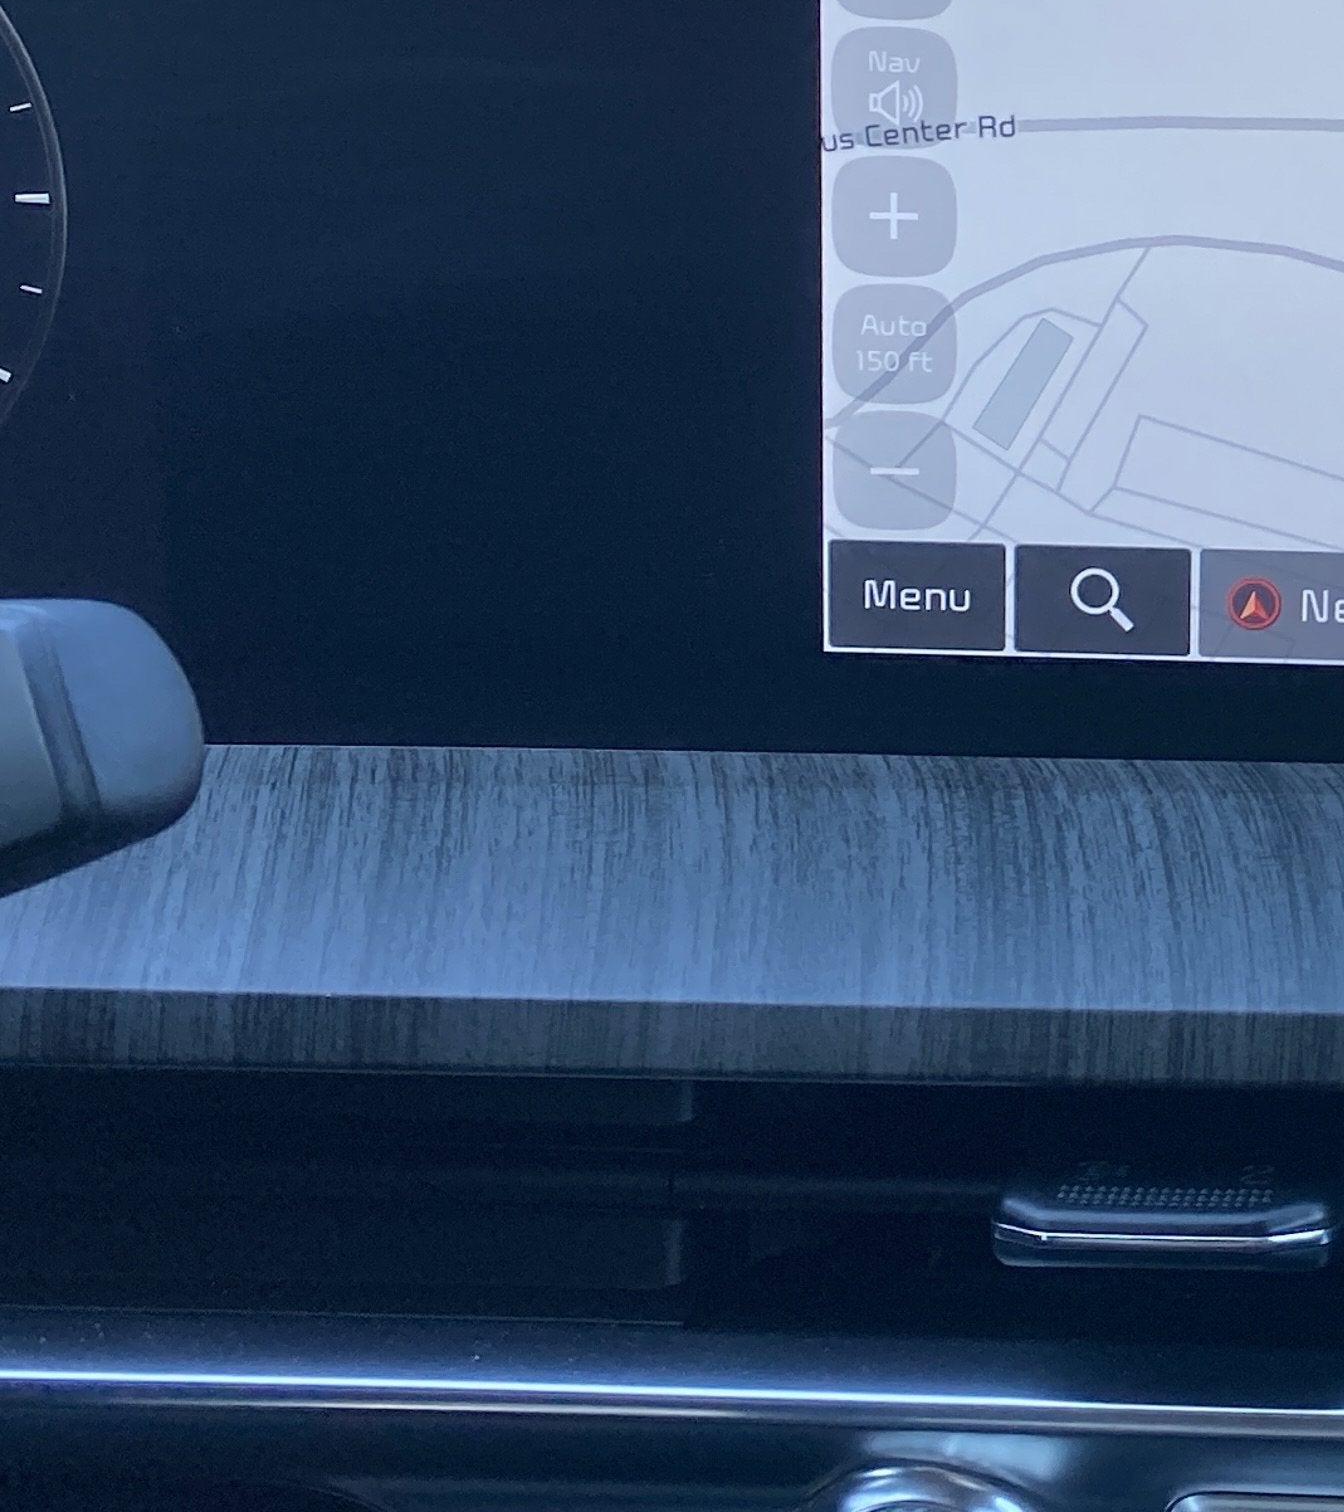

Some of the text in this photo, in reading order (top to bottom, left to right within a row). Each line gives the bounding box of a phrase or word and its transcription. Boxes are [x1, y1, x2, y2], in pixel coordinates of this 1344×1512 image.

[869, 51, 920, 73] Nav
[865, 119, 967, 147] Center
[979, 115, 1016, 138] Rd
[860, 315, 928, 338] Auto
[856, 350, 934, 374] 150 ft
[863, 579, 972, 612] Menu
